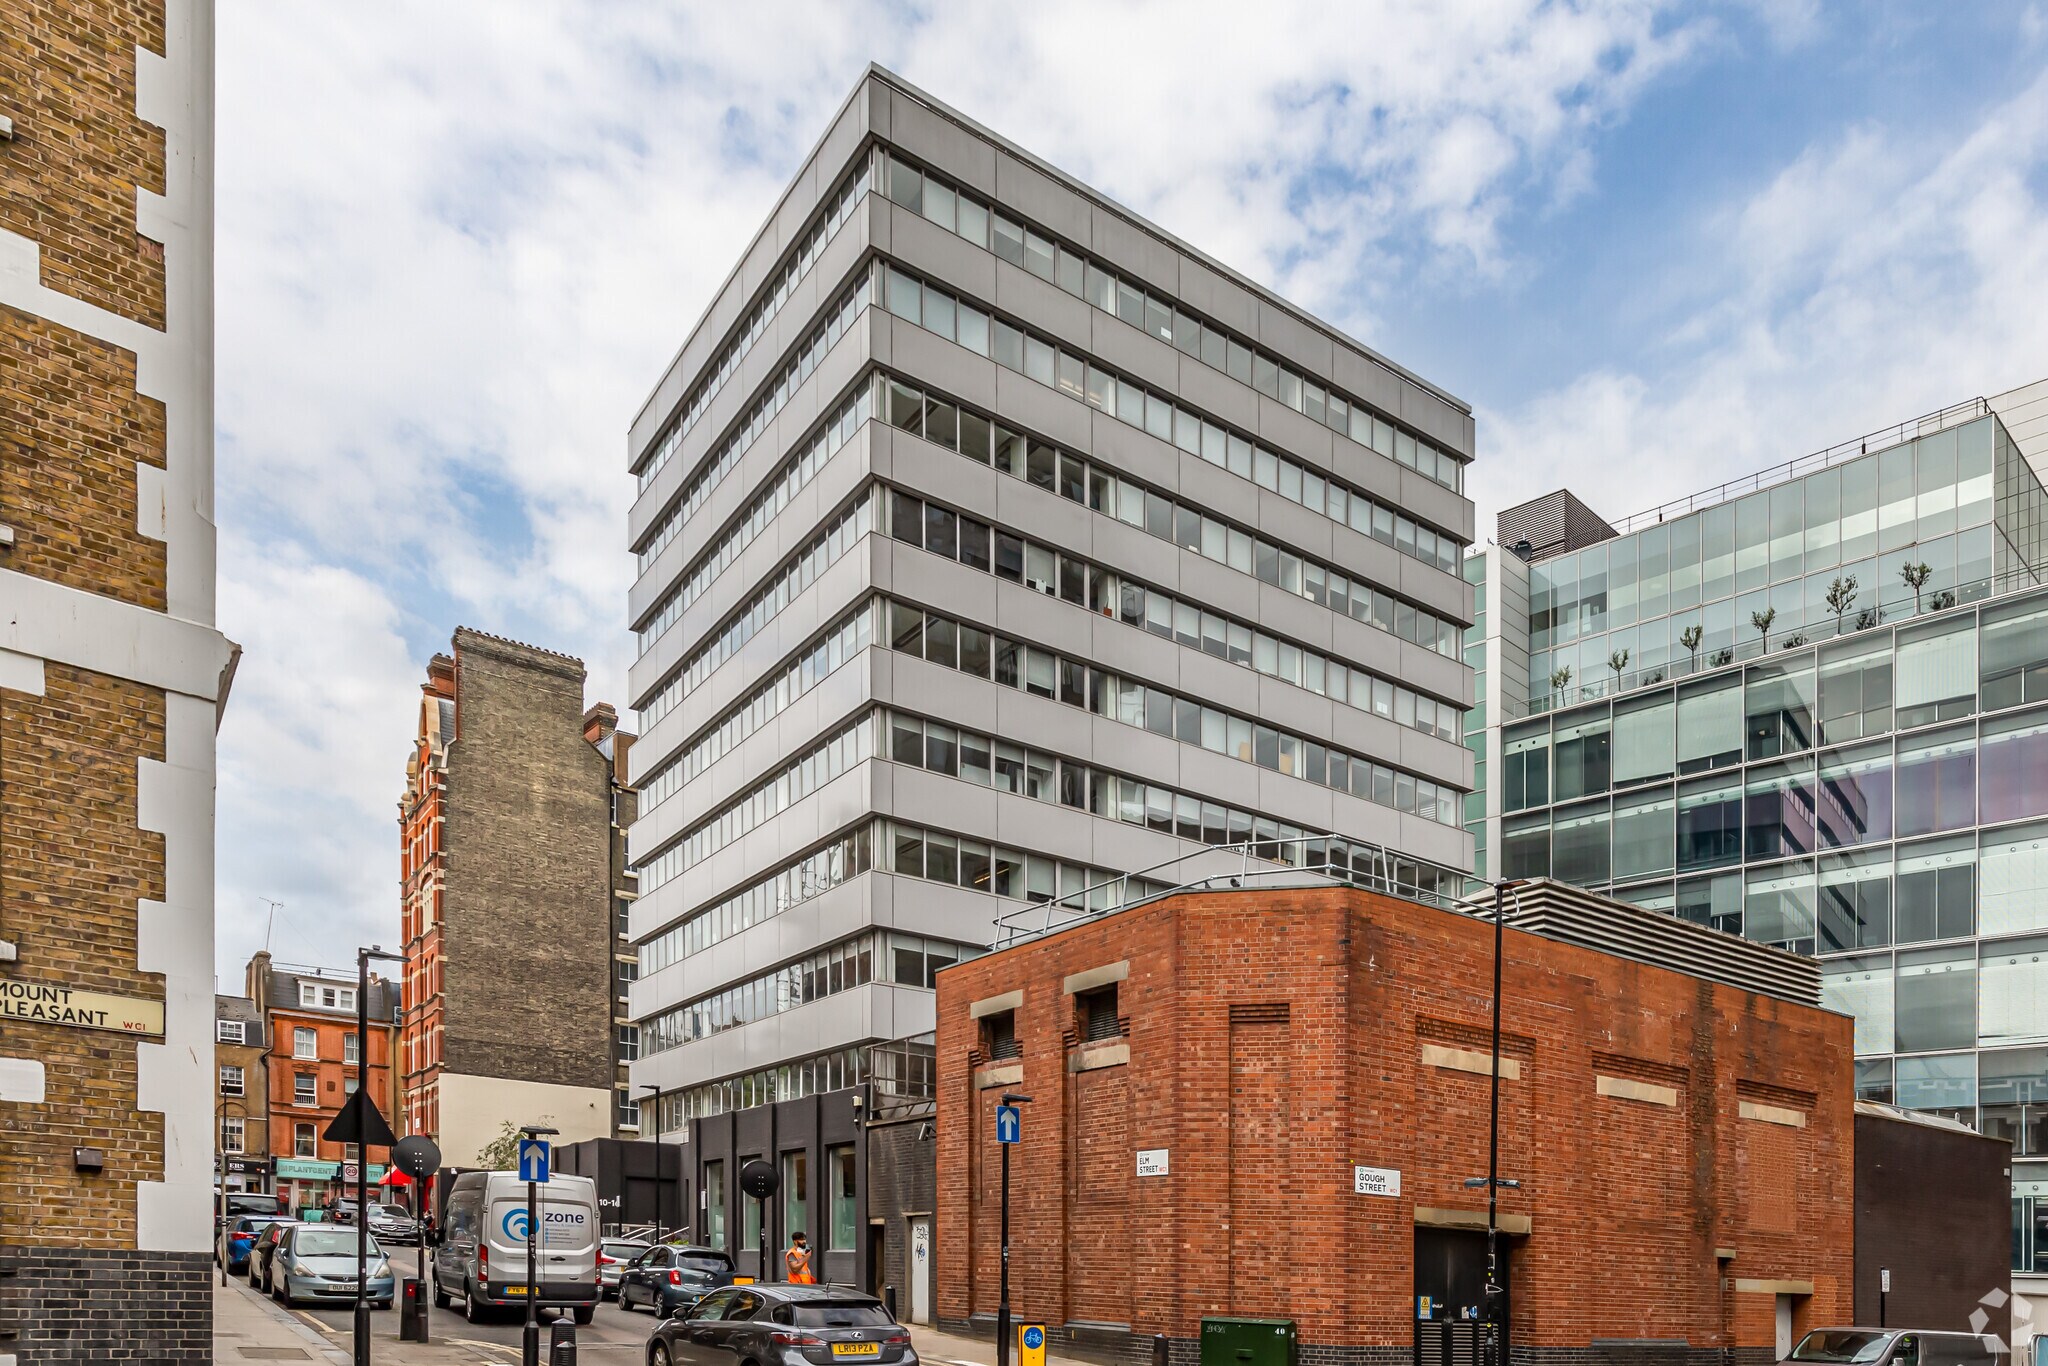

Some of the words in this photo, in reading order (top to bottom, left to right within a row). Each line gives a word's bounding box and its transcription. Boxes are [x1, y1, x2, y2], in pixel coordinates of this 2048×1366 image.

[0, 999, 109, 1026] LEASANT
[1139, 1156, 1150, 1165] ELM
[1139, 1165, 1159, 1174] STREET
[1359, 1173, 1386, 1184] GOUGH
[1359, 1182, 1387, 1193] STREET
[545, 1212, 585, 1224] zone
[1274, 1327, 1286, 1335] 40
[838, 1343, 857, 1353] LR13
[858, 1343, 874, 1353] PZA
